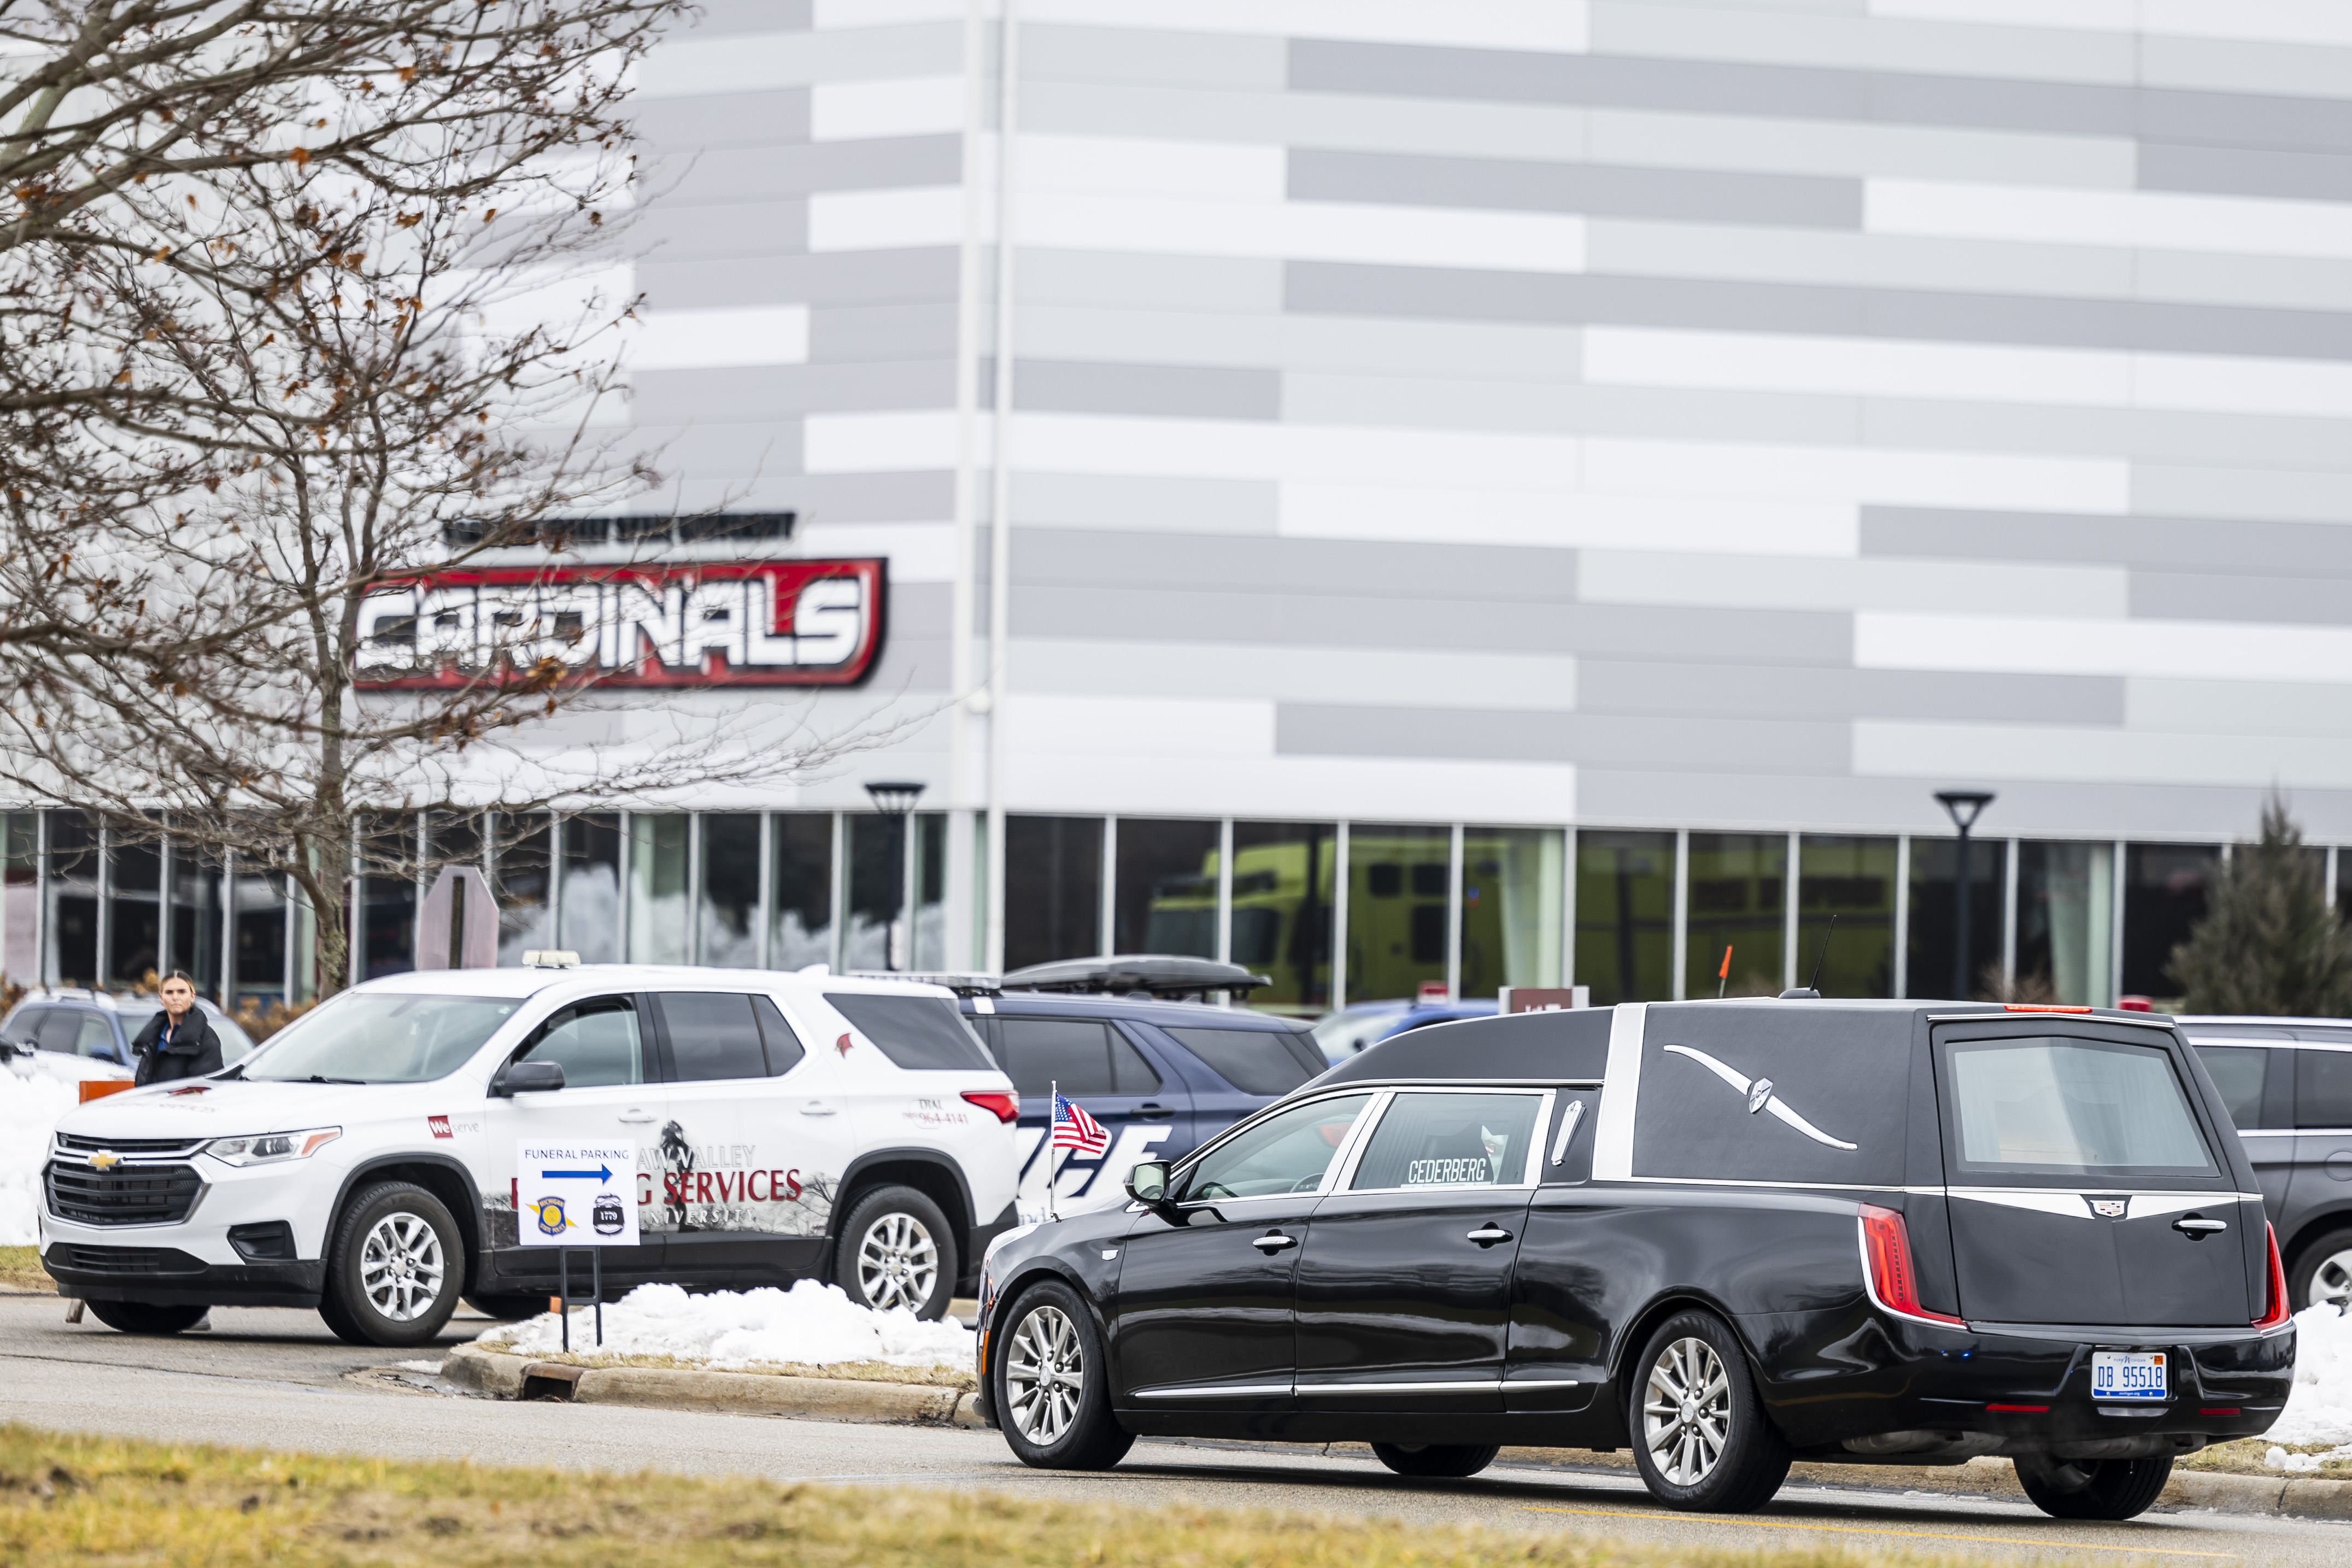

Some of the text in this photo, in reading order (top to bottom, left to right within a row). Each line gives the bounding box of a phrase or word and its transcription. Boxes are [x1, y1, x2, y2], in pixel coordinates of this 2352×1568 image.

[354, 577, 862, 670] CARDINALS
[429, 1120, 480, 1134] We serve
[525, 1149, 629, 1159] FUNERAL PARKING
[677, 1145, 756, 1169] VALLEY
[1408, 1158, 1486, 1184] CEDERBERG
[664, 1168, 802, 1205] SERVICES
[600, 1211, 618, 1220] 1779
[638, 1207, 756, 1225] UNIVERSITY
[2098, 1366, 2162, 1388] DB 95518
